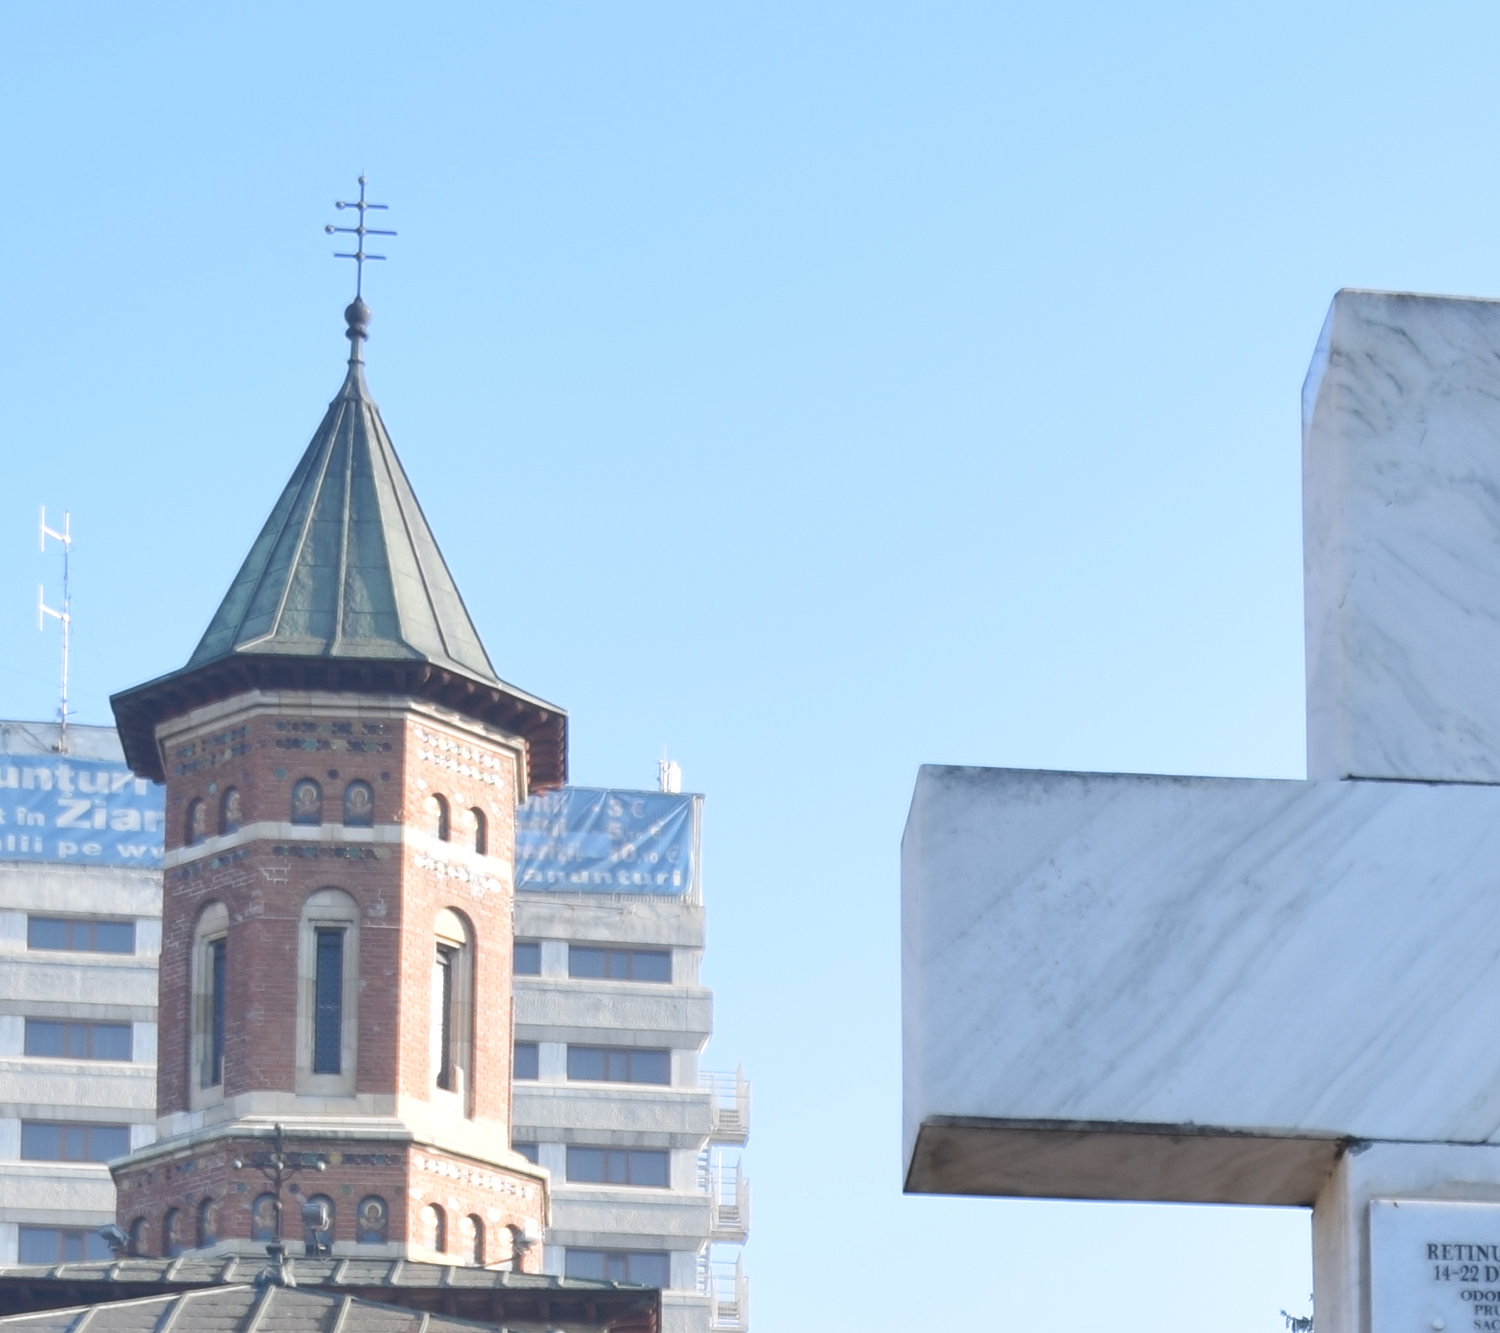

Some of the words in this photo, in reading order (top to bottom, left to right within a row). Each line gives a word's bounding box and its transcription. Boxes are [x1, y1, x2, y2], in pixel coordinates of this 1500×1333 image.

[16, 806, 45, 827] în
[56, 798, 164, 832] Ziar
[59, 841, 102, 858] pe
[1434, 1266, 1479, 1282] 14-22
